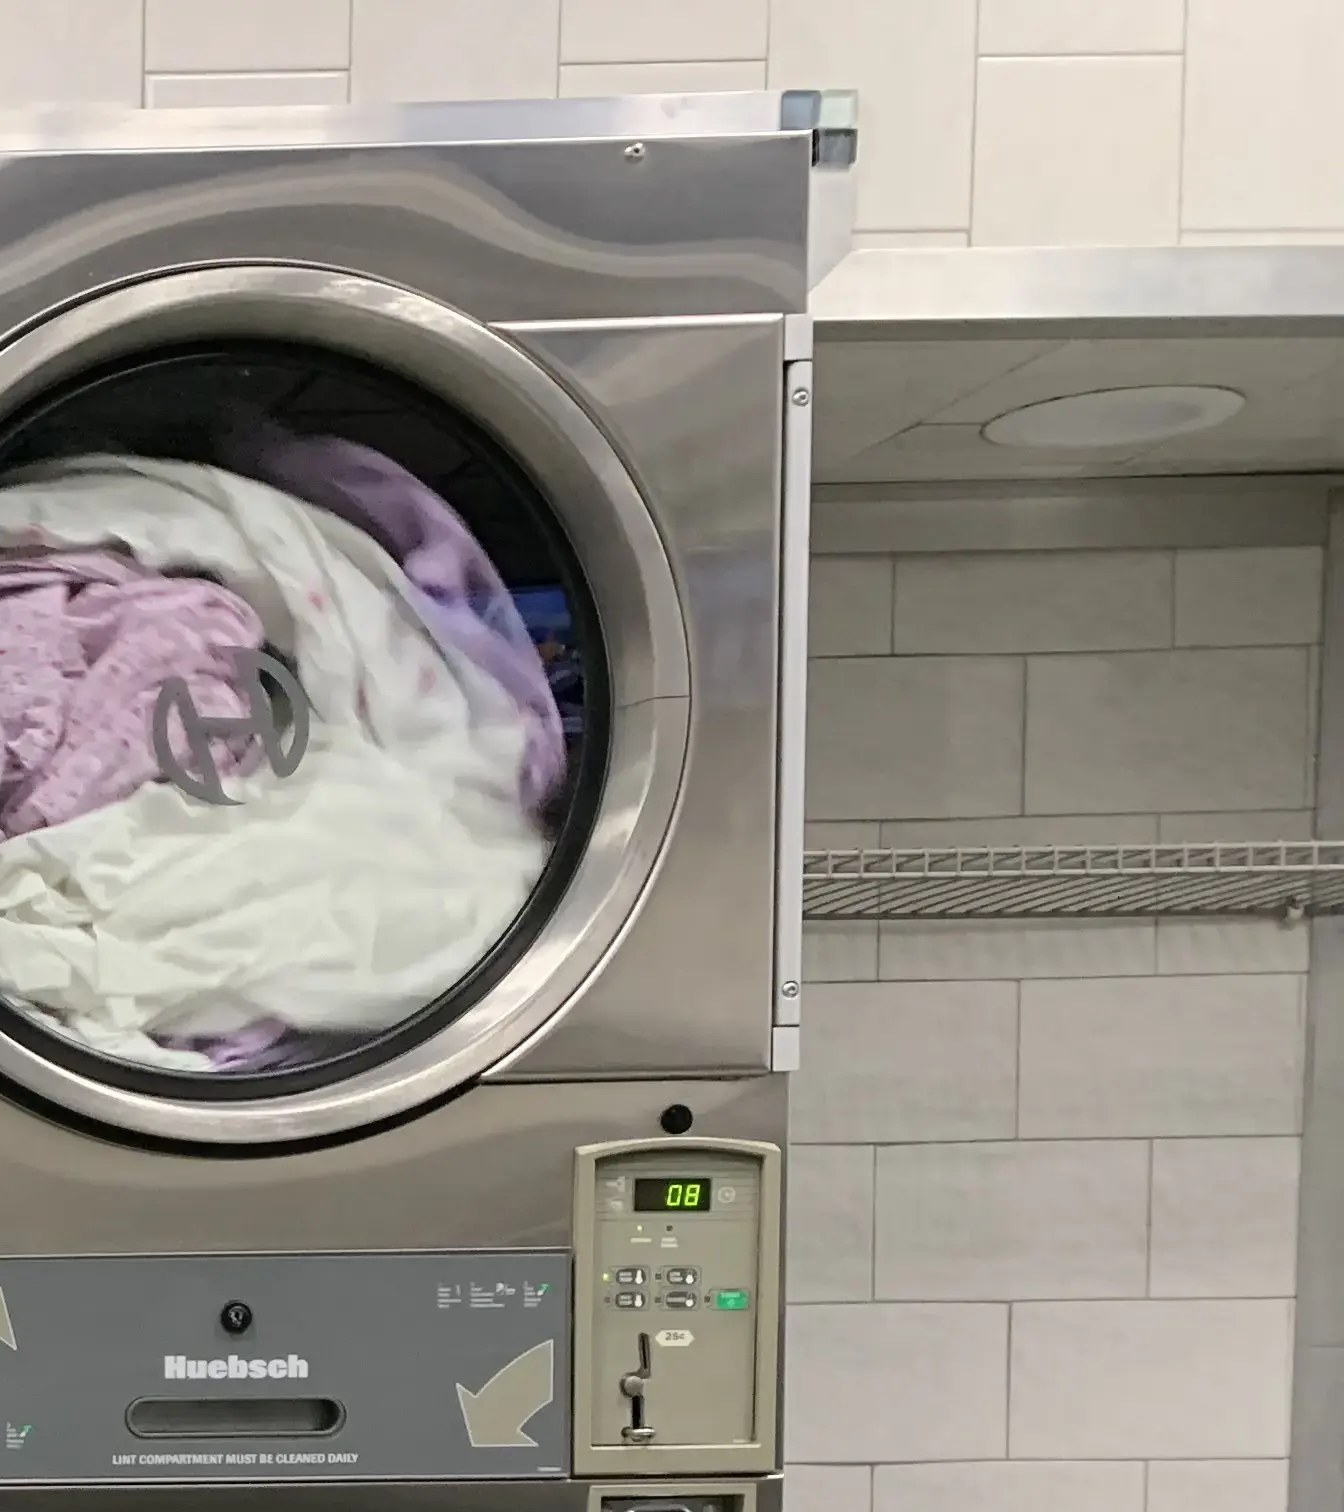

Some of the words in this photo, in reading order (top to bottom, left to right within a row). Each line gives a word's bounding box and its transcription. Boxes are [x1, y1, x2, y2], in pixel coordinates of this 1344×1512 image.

[665, 1183, 701, 1207] 08
[164, 1354, 309, 1380] Huebsch
[112, 1454, 137, 1465] LINT
[139, 1454, 224, 1465] COMPARTMENT
[226, 1454, 257, 1465] MUST
[259, 1453, 274, 1464] BE
[276, 1453, 326, 1464] CLEANED
[328, 1453, 359, 1463] DAILY
